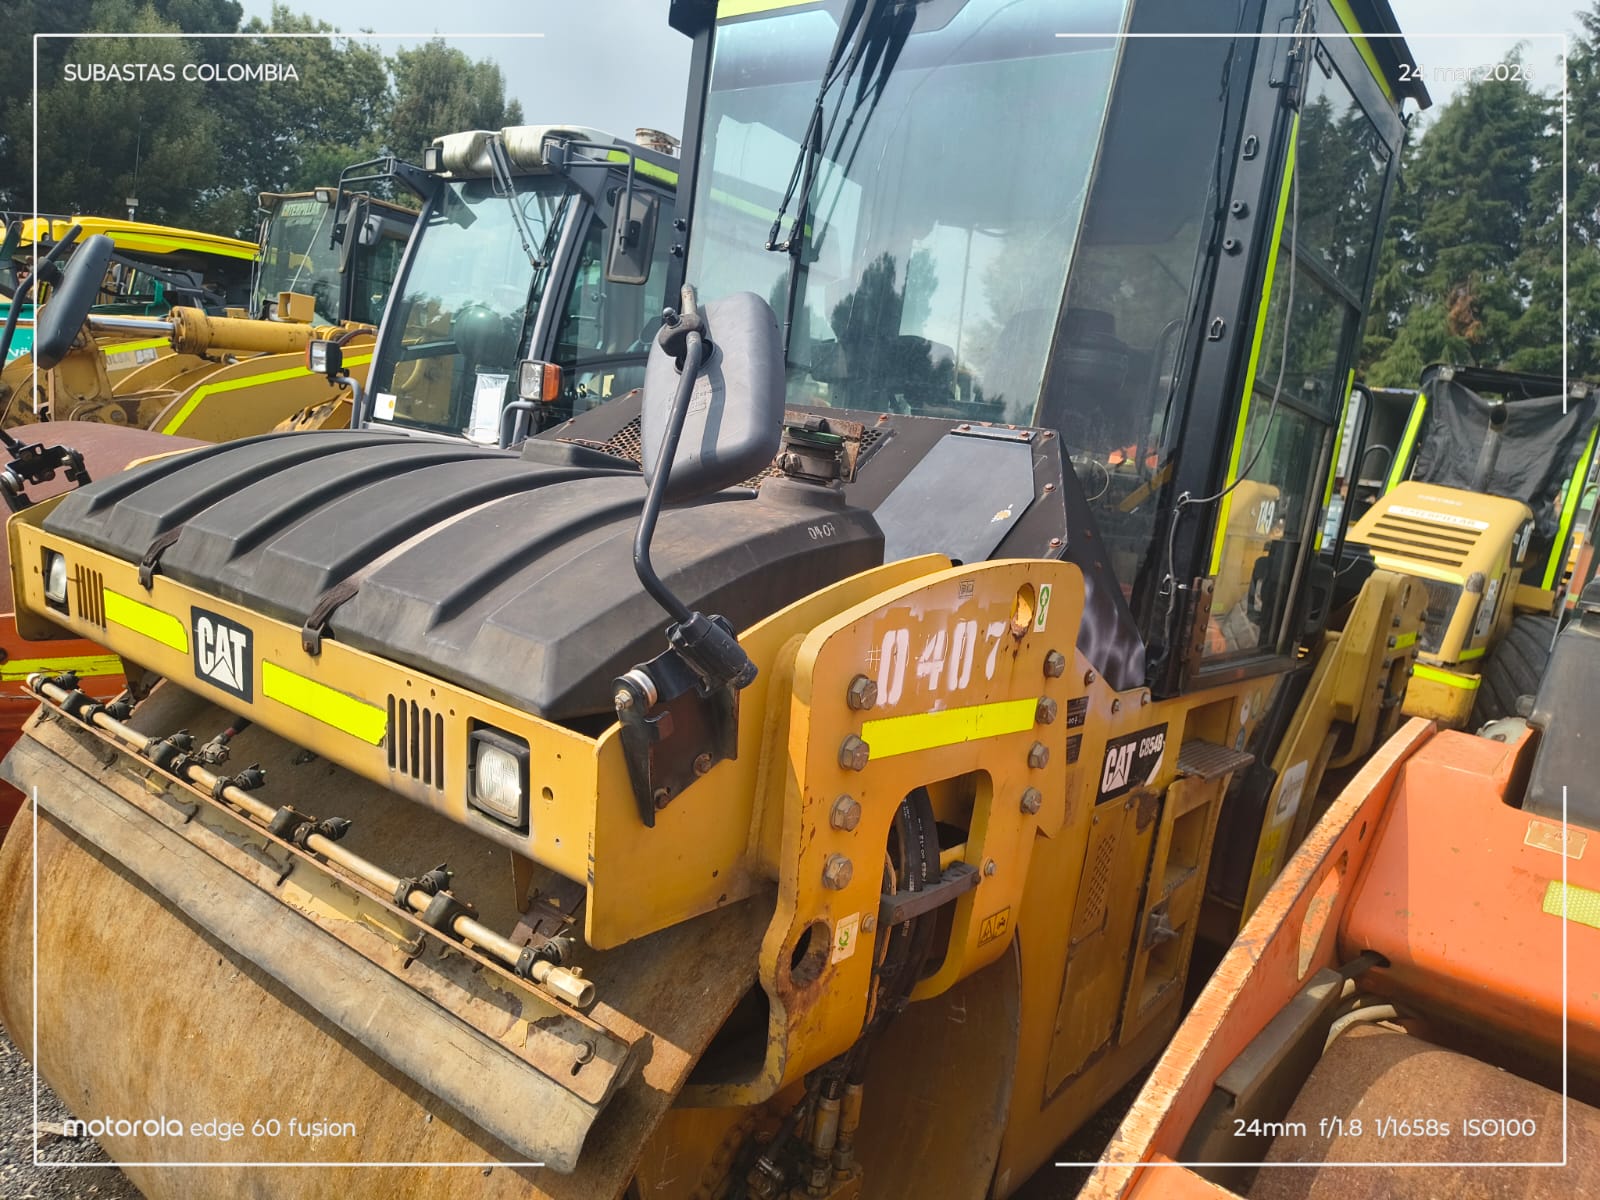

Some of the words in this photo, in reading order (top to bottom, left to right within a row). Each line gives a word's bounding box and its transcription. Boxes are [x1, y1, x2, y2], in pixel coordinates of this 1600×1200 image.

[807, 521, 837, 541] 0407
[196, 614, 248, 692] CAT
[875, 618, 1007, 707] 0407
[1100, 741, 1138, 795] CAT
